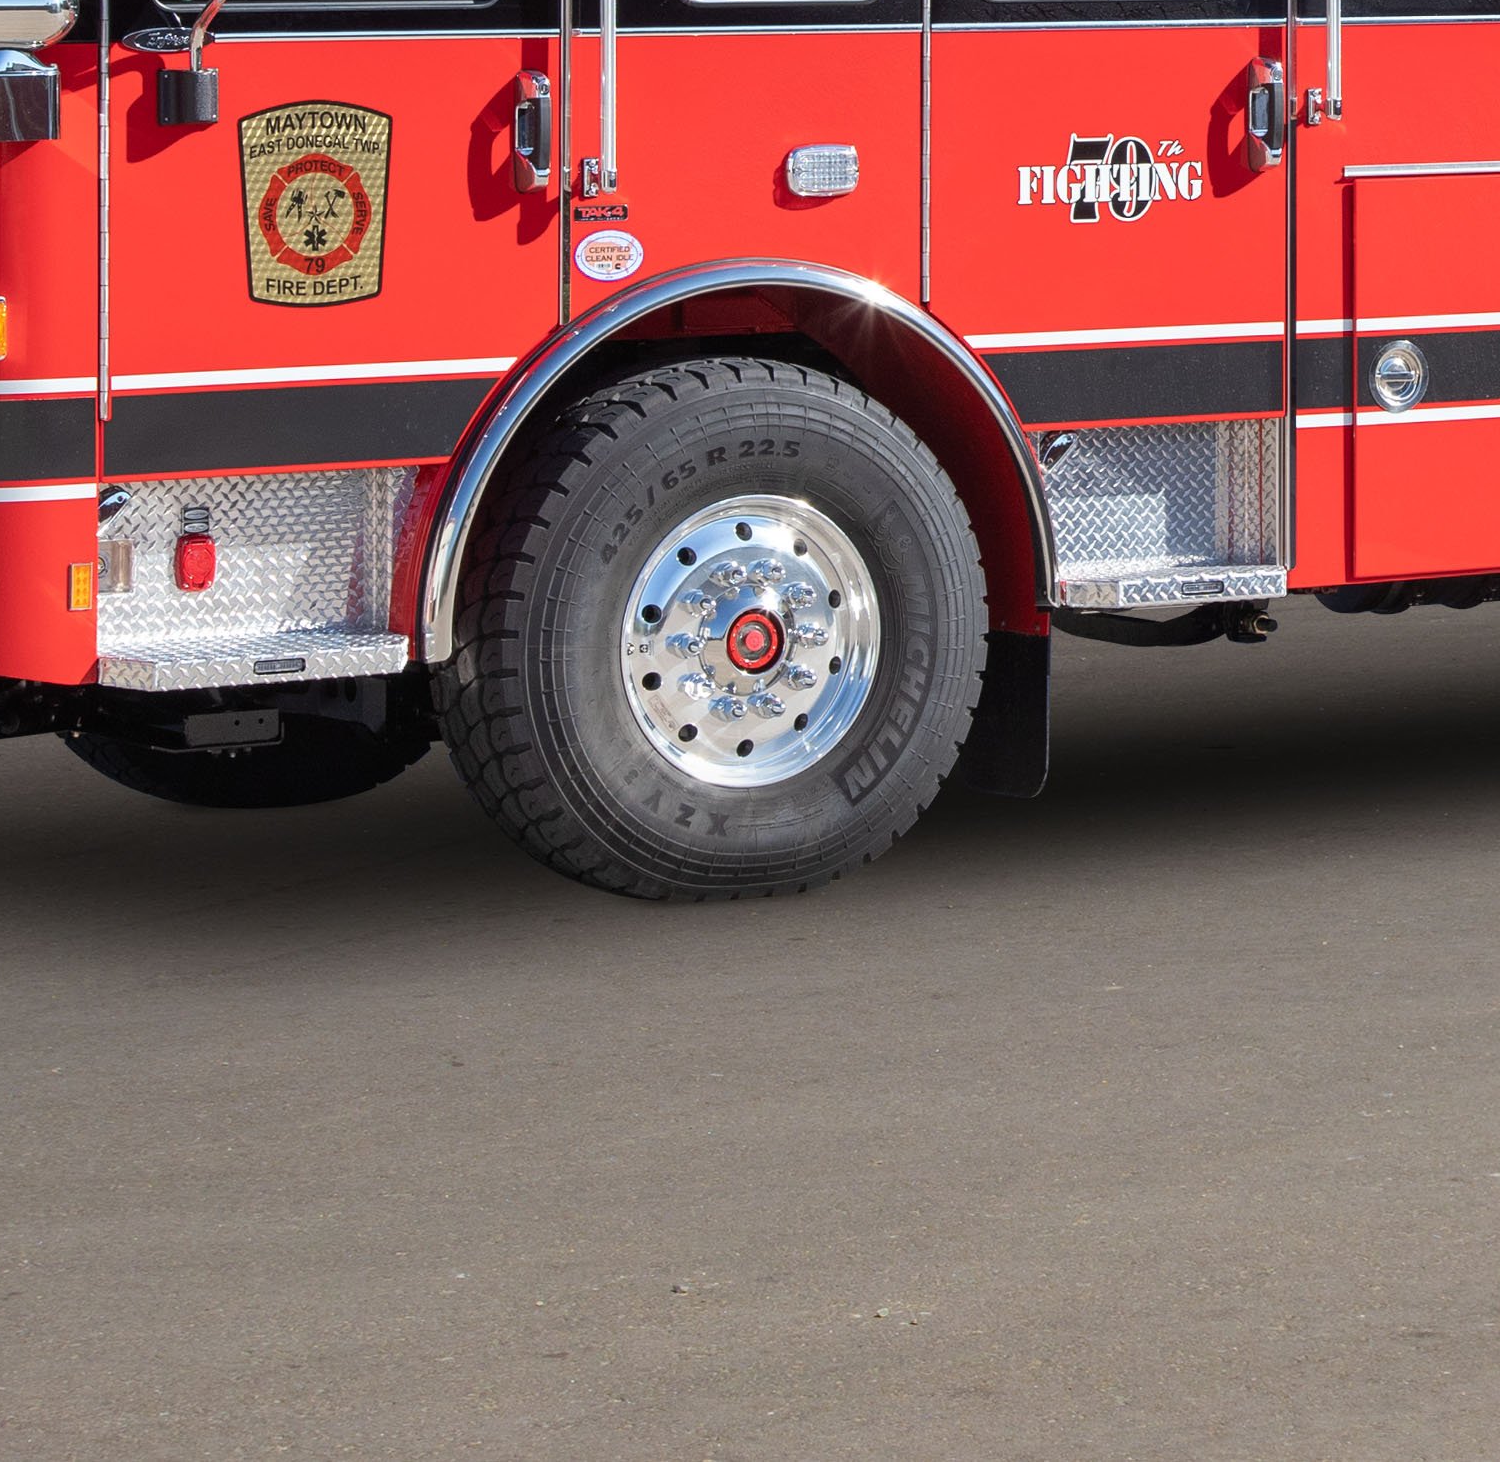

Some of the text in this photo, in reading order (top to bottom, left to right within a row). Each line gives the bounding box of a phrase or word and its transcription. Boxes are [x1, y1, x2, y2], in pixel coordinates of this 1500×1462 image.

[266, 111, 367, 136] MAYTOWN
[250, 135, 382, 159] EAST DONEGAL TWP.
[287, 160, 345, 176] PROTECT
[1017, 161, 1203, 205] FIGHTING
[262, 197, 277, 231] SAVE
[352, 191, 367, 235] SERVE
[589, 246, 630, 254] CERTIFIED
[304, 257, 326, 275] 79
[266, 275, 363, 296] FIRE DEPT.
[844, 573, 931, 801] MICHELIN
